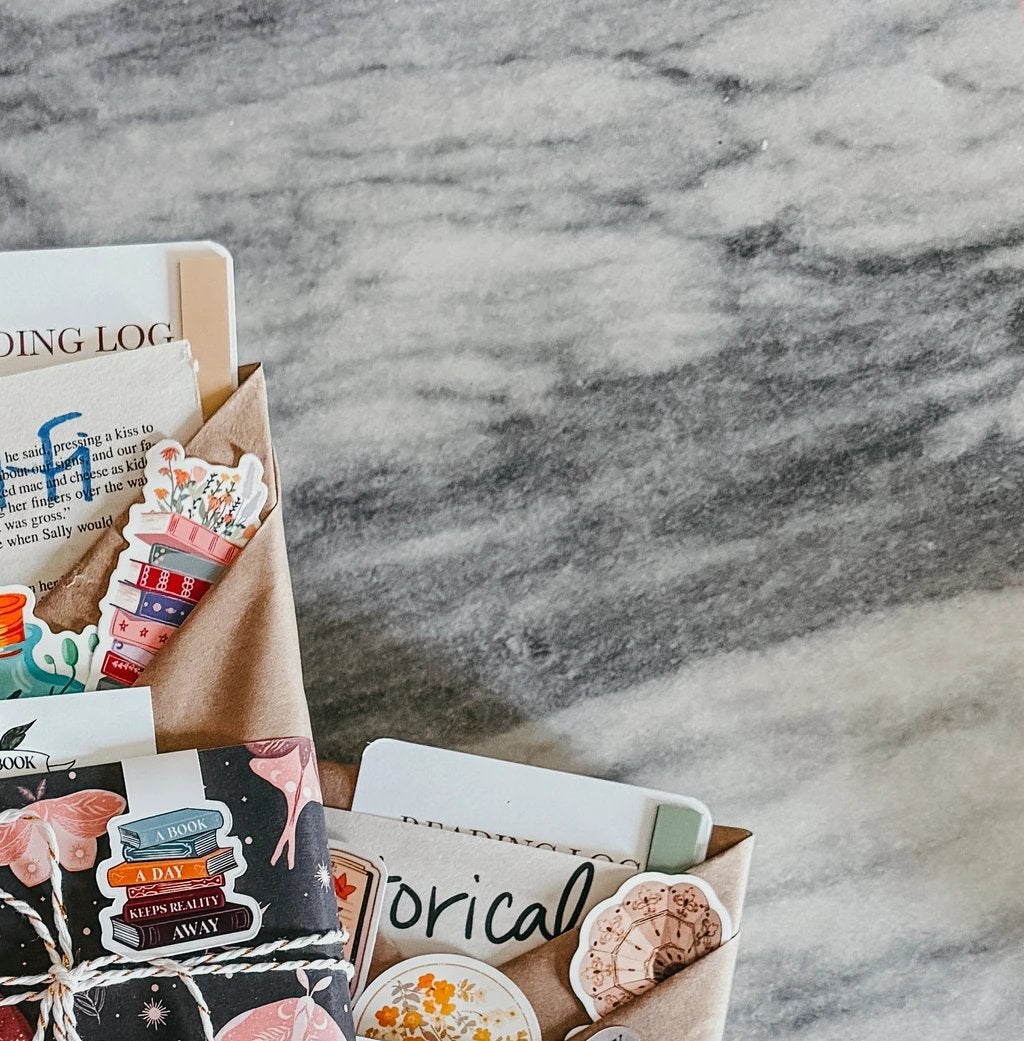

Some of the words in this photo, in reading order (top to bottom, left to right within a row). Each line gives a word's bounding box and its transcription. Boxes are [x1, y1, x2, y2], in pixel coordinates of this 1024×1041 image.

[94, 321, 175, 352] LOG
[5, 452, 20, 463] he
[22, 444, 51, 459] said,
[53, 433, 103, 456] pressing
[105, 433, 112, 442] a
[115, 426, 139, 440] kiss
[141, 424, 154, 434] to
[31, 463, 51, 475] our
[92, 447, 114, 462] and
[116, 444, 138, 457] our
[140, 439, 157, 453] fa-
[8, 500, 28, 513] her
[32, 493, 72, 510] fingers
[75, 486, 101, 500] over
[105, 481, 124, 494] the
[127, 476, 148, 488] wa
[19, 481, 44, 494] mac
[46, 473, 67, 489] and
[70, 469, 109, 484] cheese
[111, 465, 124, 477] as
[5, 519, 27, 530] was
[31, 506, 71, 528] gross.”
[7, 533, 39, 547] when
[42, 525, 73, 541] Sally
[77, 515, 114, 533] would
[155, 831, 166, 843] A
[167, 817, 208, 838] BOOK
[135, 869, 147, 882] A
[152, 864, 185, 881] DAY
[129, 904, 168, 919] KEEPS
[169, 895, 220, 912] REALITY
[387, 861, 595, 945] orical
[172, 917, 220, 941] AWAY
